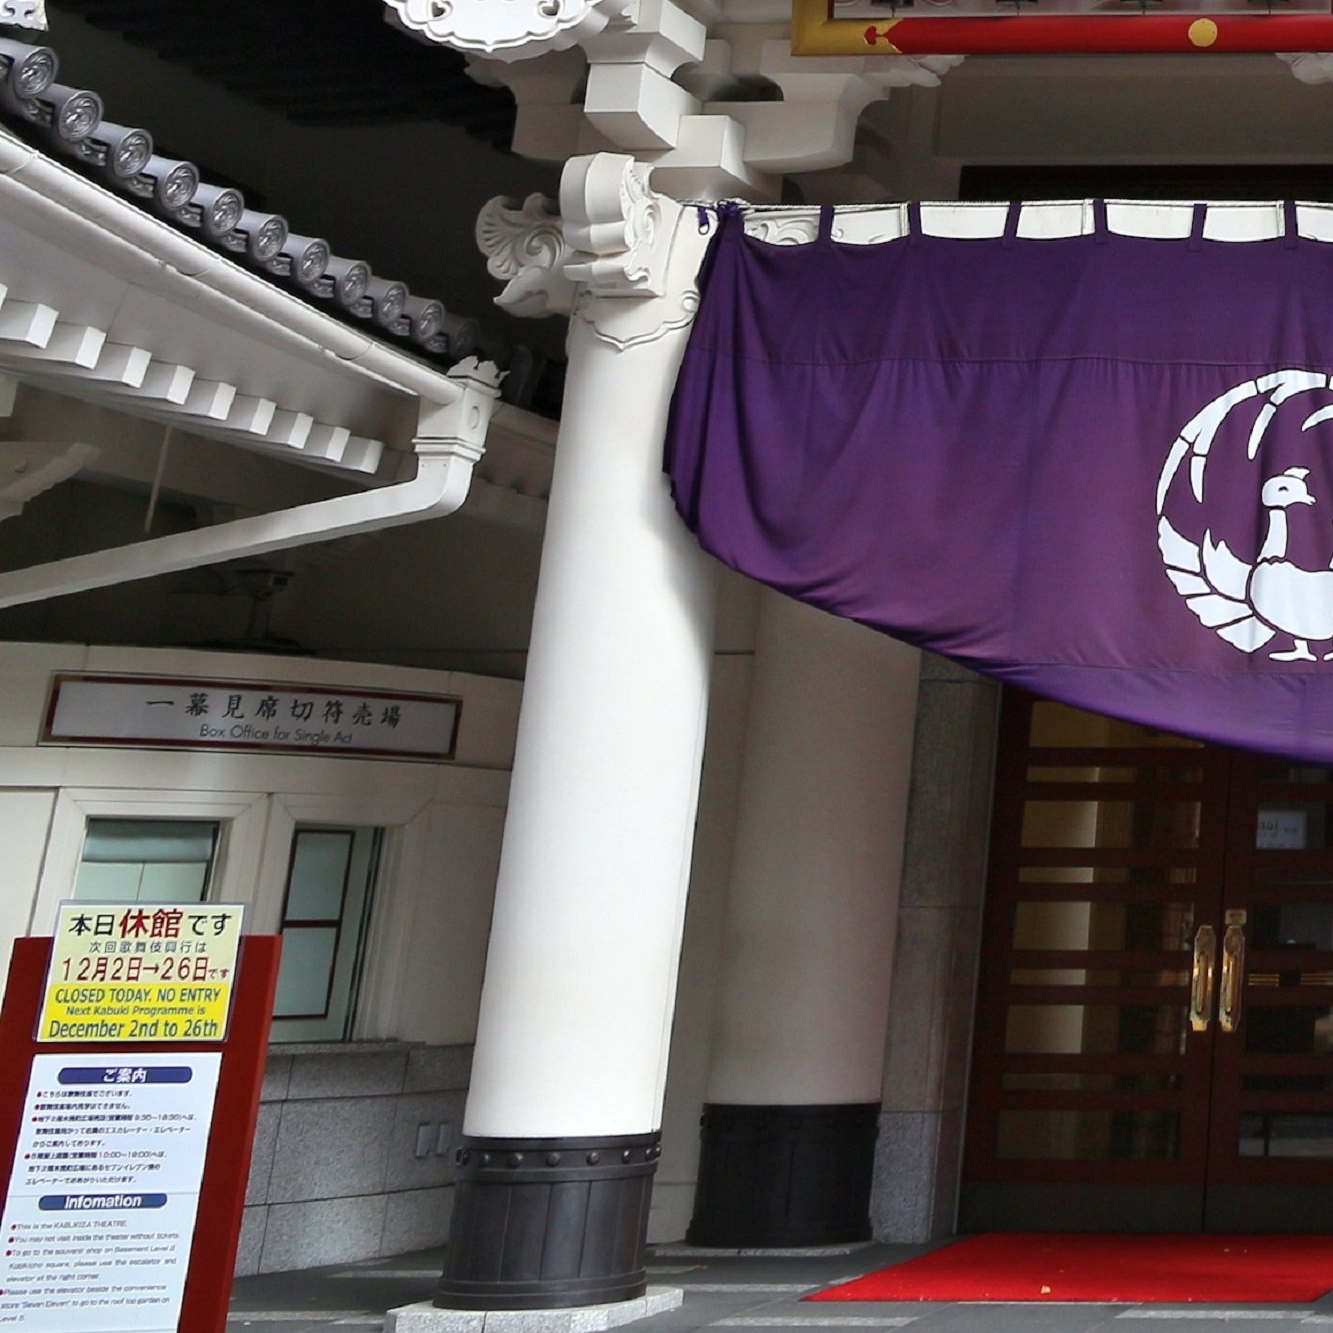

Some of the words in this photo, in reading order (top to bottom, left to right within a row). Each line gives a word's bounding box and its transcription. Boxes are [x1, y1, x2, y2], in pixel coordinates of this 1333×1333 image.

[146, 692, 402, 728] 一幕見席切符売場
[200, 724, 224, 738] Box
[230, 724, 269, 740] Office
[274, 725, 290, 741] for
[294, 726, 330, 745] Single
[68, 908, 232, 938] 本日休館です
[55, 988, 105, 1003] CLOSED
[157, 988, 176, 1002] NO
[180, 987, 222, 1002] ENTRY
[66, 1006, 91, 1015] Next
[93, 1005, 129, 1015] Kabuki
[132, 1005, 194, 1017] Programme
[197, 1005, 206, 1015] is
[49, 1020, 125, 1038] December
[129, 1019, 159, 1037] 2nd
[163, 1022, 179, 1037] to
[183, 1018, 218, 1037] 26th
[103, 1068, 147, 1083] ご案内
[63, 1195, 142, 1210] Infomation
